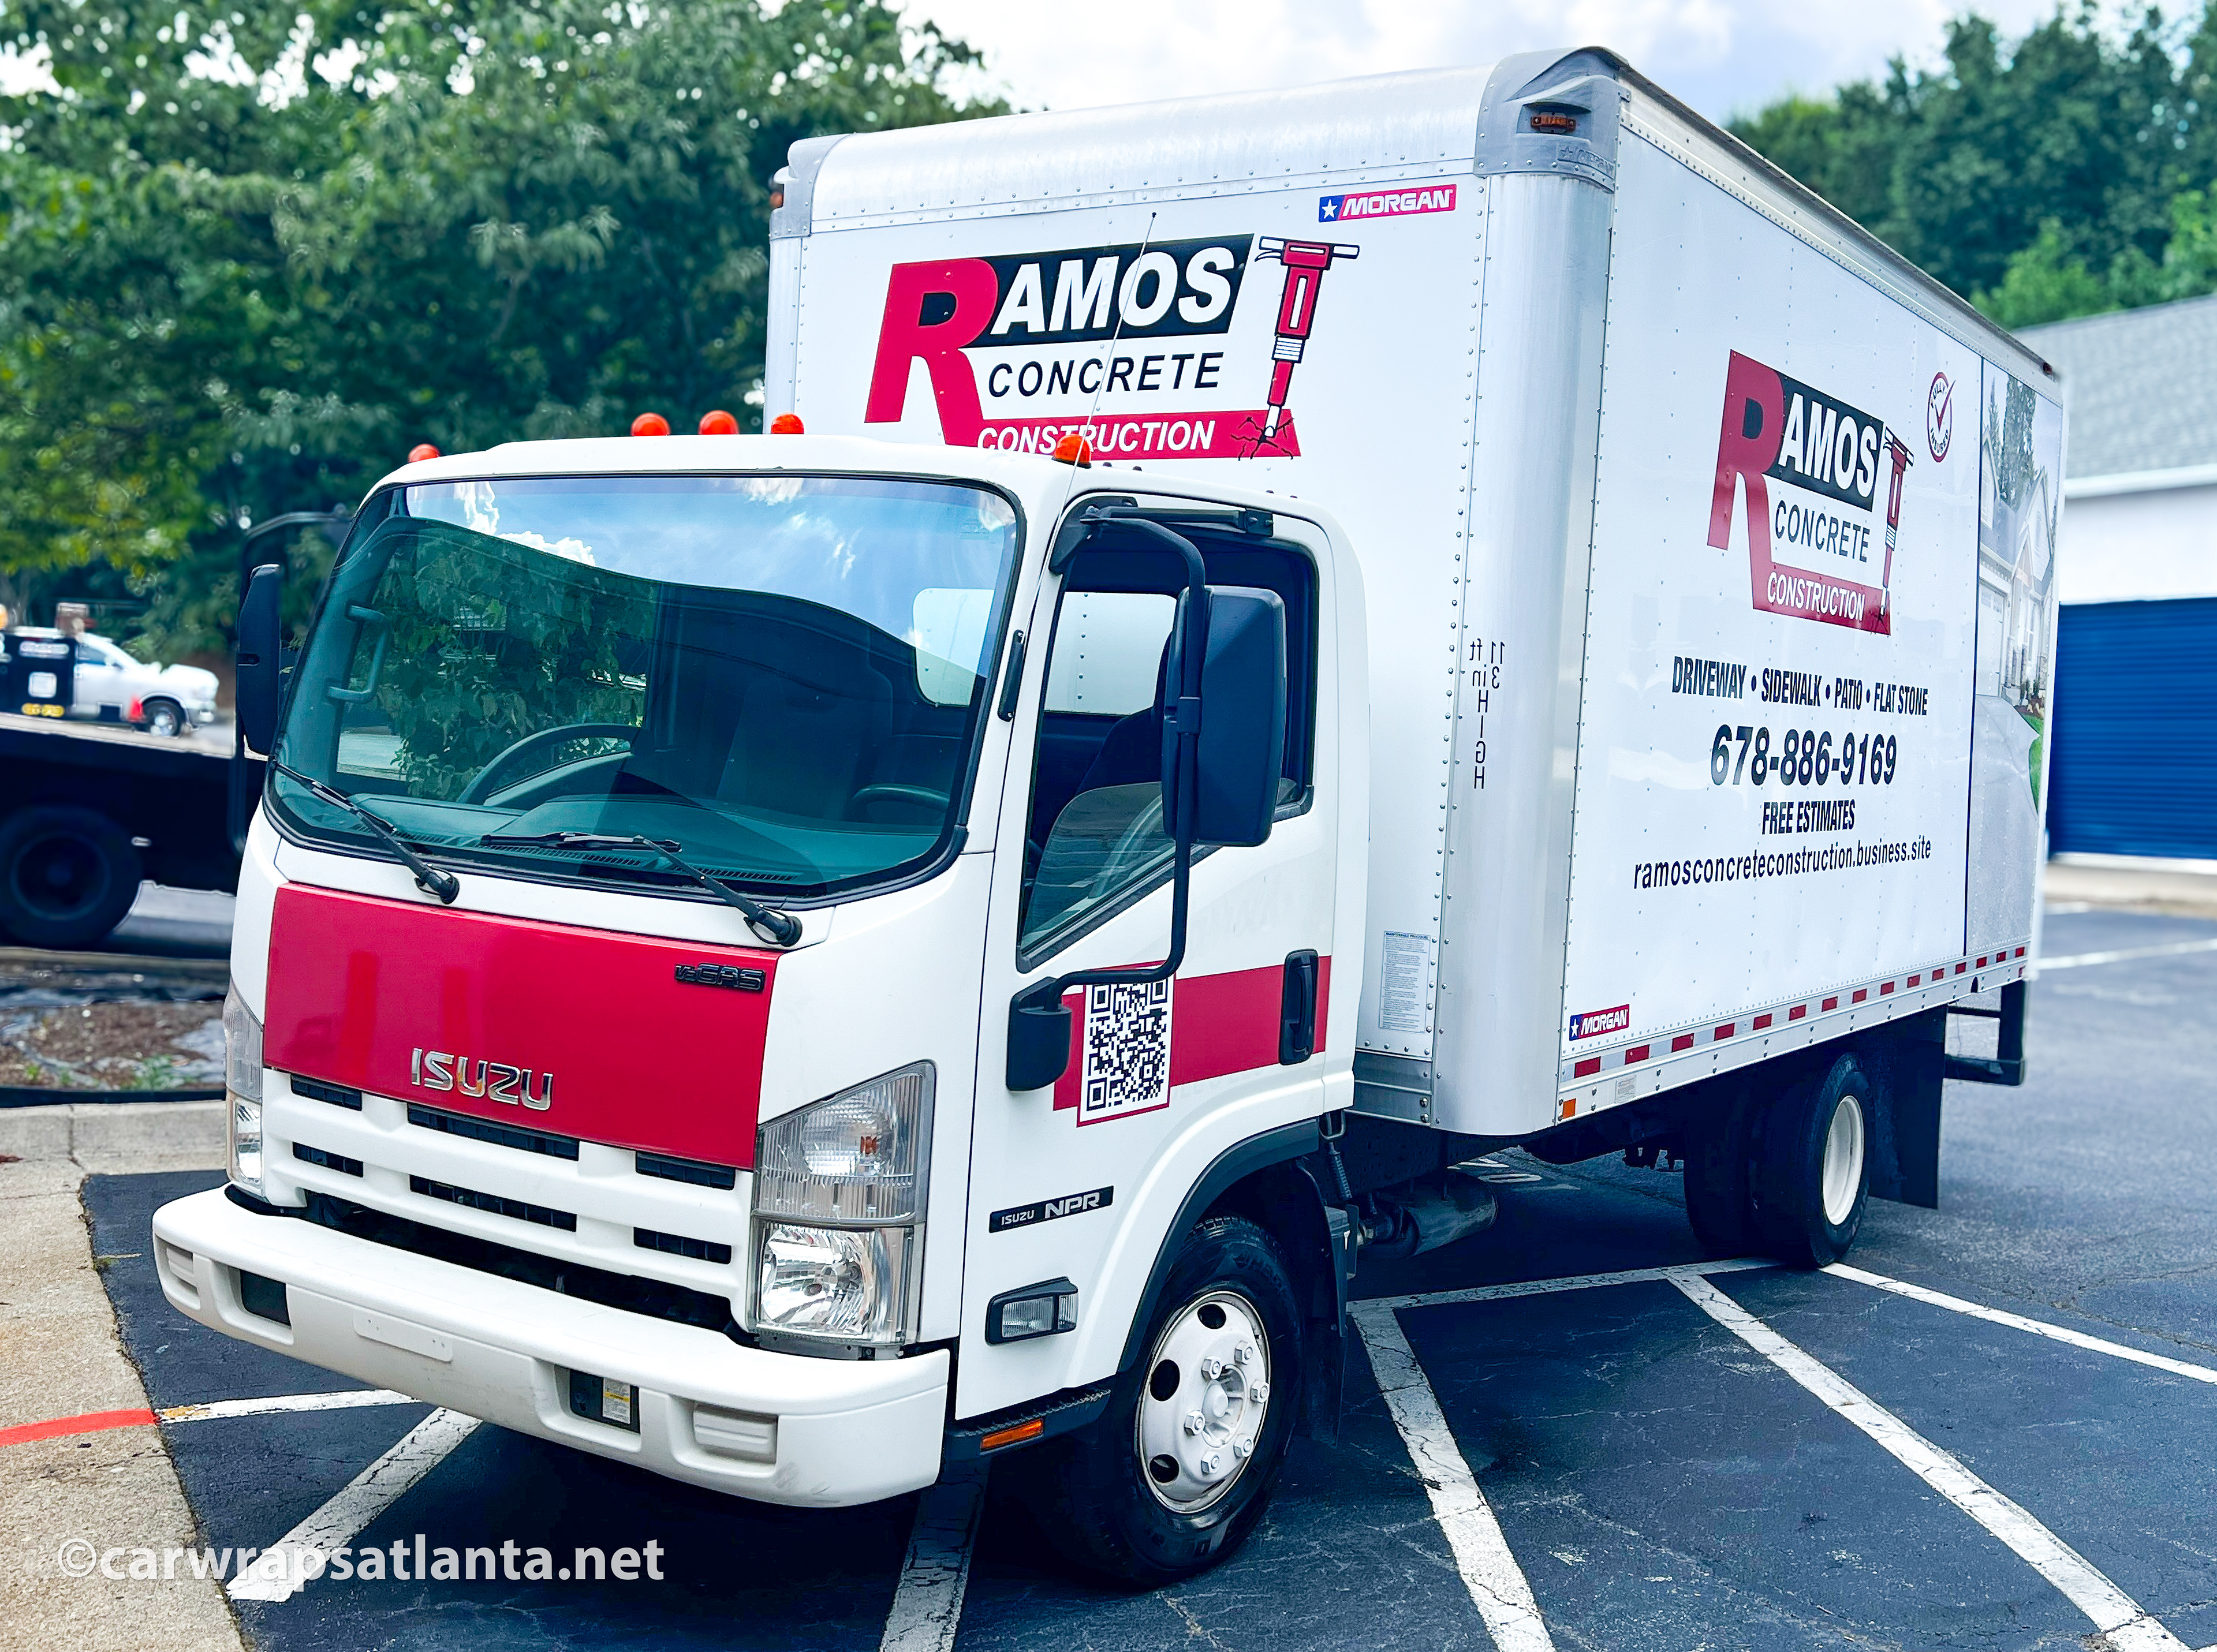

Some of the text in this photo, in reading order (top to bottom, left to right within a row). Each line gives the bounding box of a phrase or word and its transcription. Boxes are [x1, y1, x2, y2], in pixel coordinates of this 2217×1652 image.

[1342, 189, 1453, 216] MORGAN
[865, 246, 1235, 444] RAMOS
[989, 352, 1223, 397] CONCRETE
[977, 420, 1215, 454] CONSTRUCTION
[1707, 349, 1878, 610] RAMOS
[1775, 500, 1870, 563] CONCRETE
[1767, 571, 1865, 621] CONSTRUCTION
[1672, 656, 1928, 716] DRIVEWAY SIDEWALK PATIO FLAT STONE
[1711, 724, 1897, 786] 678-886-9169
[1761, 799, 1856, 835] FREE ESTIMATES
[1633, 835, 1932, 889] ramosconcreteconstruction.business.site
[1580, 1010, 1628, 1035] MORGAN
[411, 1048, 554, 1111] ISUZU
[1001, 1191, 1100, 1226] ISUZU NPR
